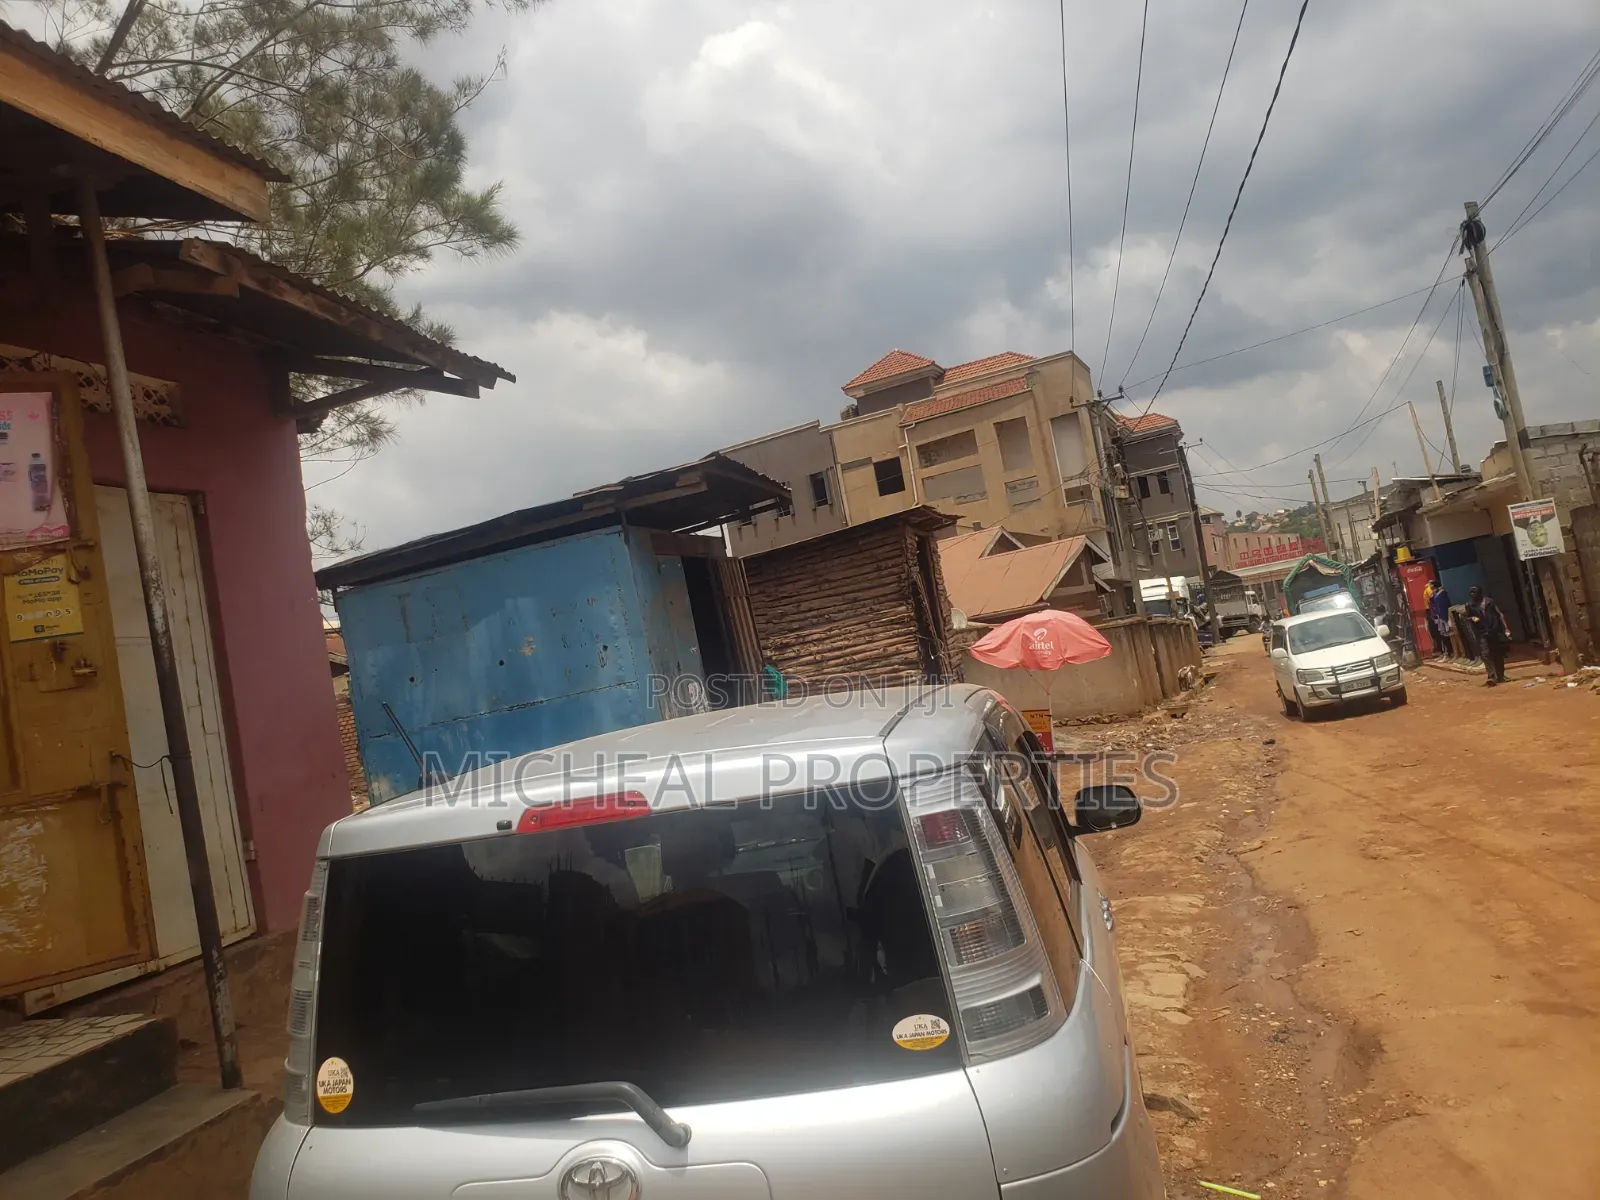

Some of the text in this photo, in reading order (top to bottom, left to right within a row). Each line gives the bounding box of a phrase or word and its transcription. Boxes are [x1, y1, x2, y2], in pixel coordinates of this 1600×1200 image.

[1029, 640, 1054, 650] airtel
[332, 1078, 351, 1086] JAPAN
[323, 1086, 347, 1094] MOTORS
